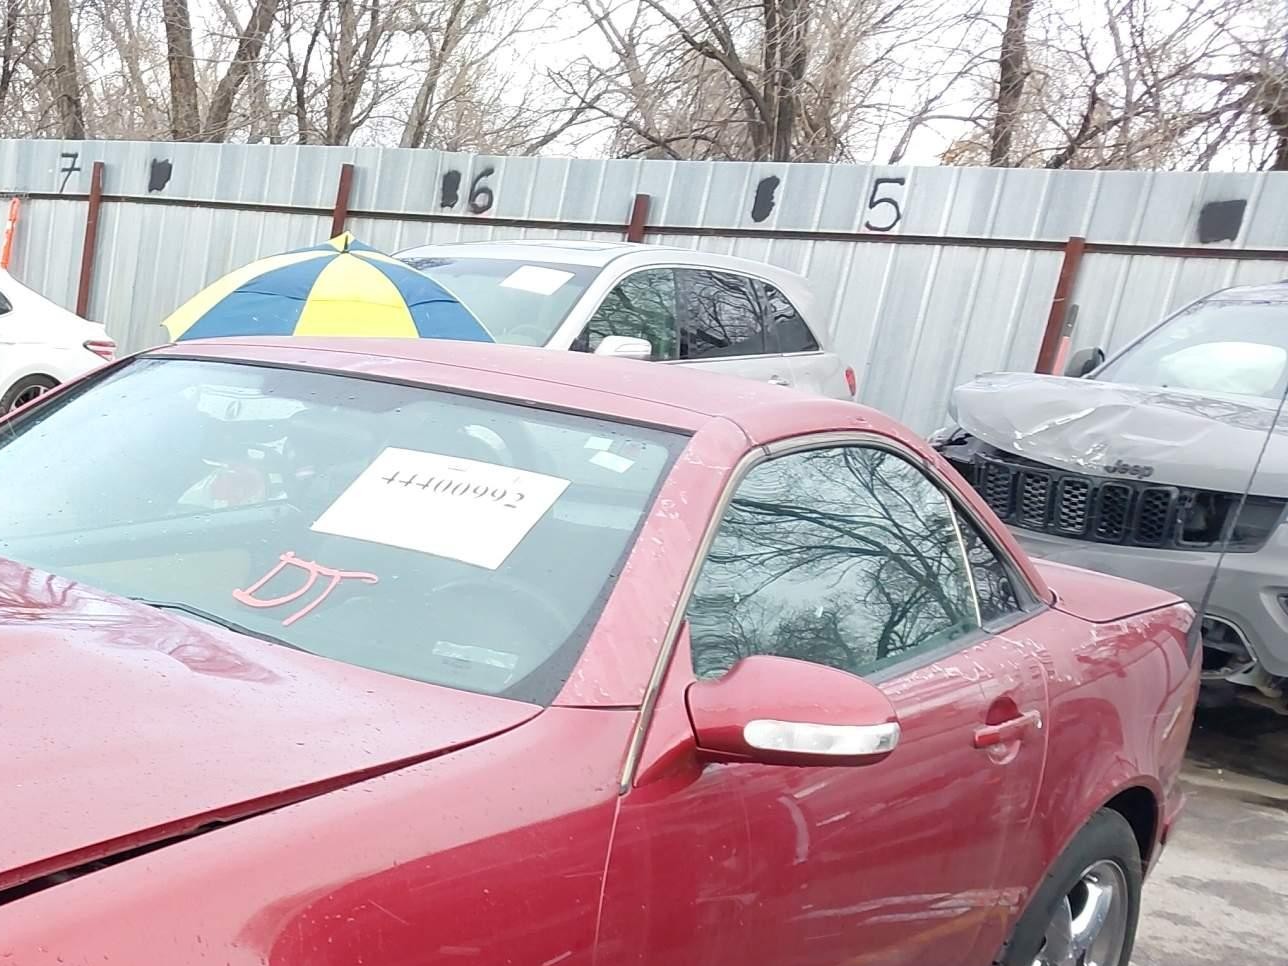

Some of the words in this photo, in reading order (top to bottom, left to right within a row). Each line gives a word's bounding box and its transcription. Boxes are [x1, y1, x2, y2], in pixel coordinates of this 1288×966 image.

[60, 152, 81, 194] 7
[468, 167, 494, 215] 6
[865, 177, 906, 232] 5
[381, 471, 525, 508] 44400992
[1103, 459, 1154, 479] Jeep
